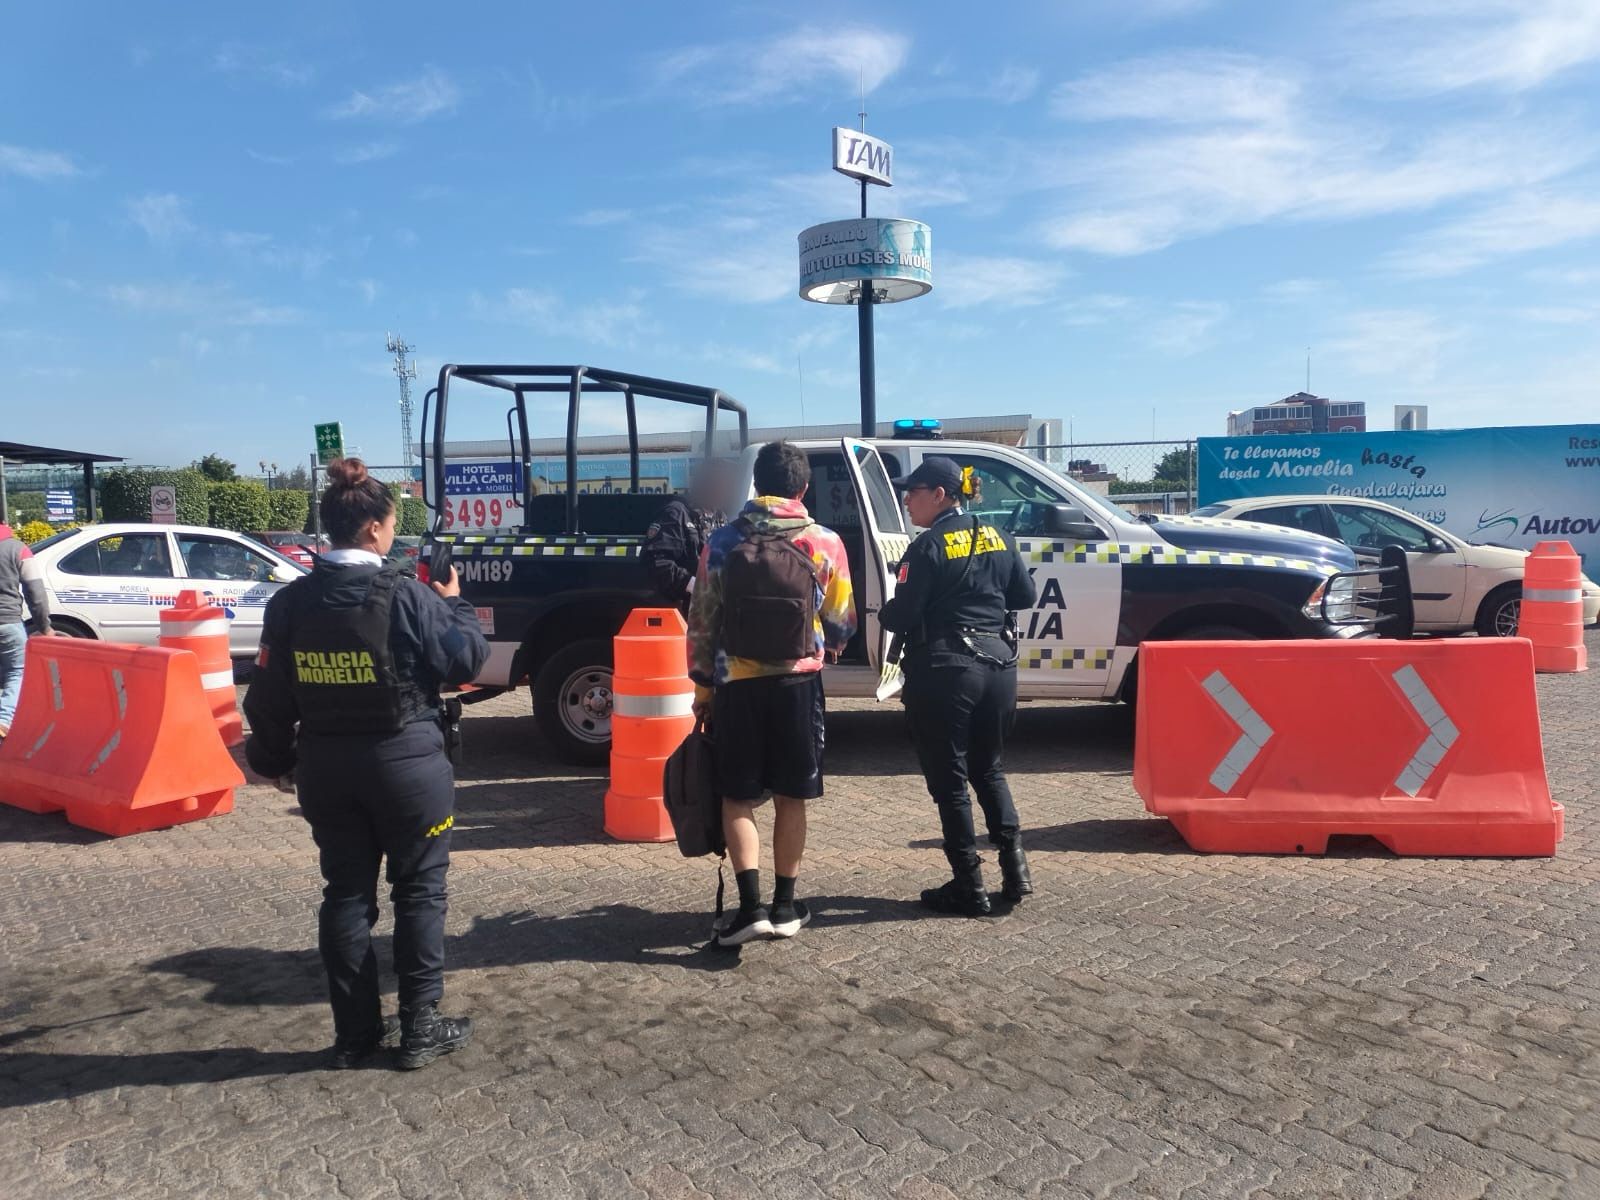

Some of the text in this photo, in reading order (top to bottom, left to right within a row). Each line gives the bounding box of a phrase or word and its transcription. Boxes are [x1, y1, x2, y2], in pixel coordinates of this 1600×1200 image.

[846, 137, 890, 176] TAM
[801, 228, 868, 256] ENVENIDO
[1223, 446, 1321, 460] Te llevamos
[463, 466, 496, 474] HOTEL
[1219, 459, 1354, 480] desde Morelia
[1361, 448, 1427, 479] hasta
[445, 475, 479, 485] VILLA
[1326, 481, 1447, 500] Guadalajara
[445, 496, 502, 528] $499
[945, 537, 1007, 560] MOELIA
[120, 585, 150, 593] MORELIA
[208, 597, 237, 607] PLUS
[294, 651, 374, 668] POLICIA
[297, 667, 377, 684] MORELIA
